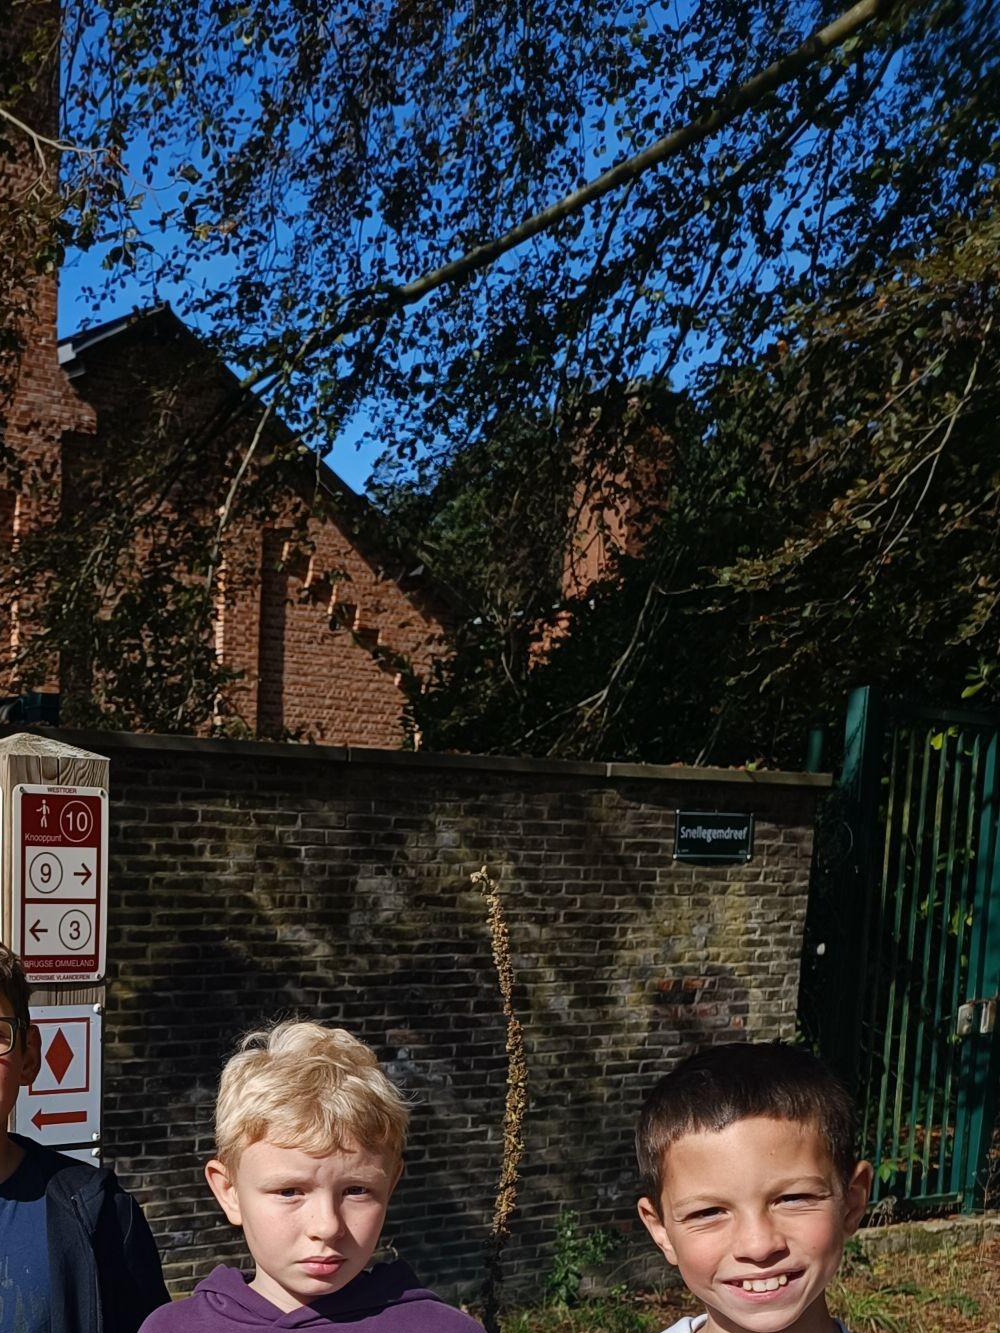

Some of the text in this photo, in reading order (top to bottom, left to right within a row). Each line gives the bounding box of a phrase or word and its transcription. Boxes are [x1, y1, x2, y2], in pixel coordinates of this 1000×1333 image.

[65, 810, 88, 832] 10
[24, 832, 62, 844] Knooppunt
[680, 825, 748, 843] Snellegemdreef
[40, 862, 52, 884] 9
[69, 920, 81, 941] 3
[24, 959, 95, 968] BRUGSE OMMELAND
